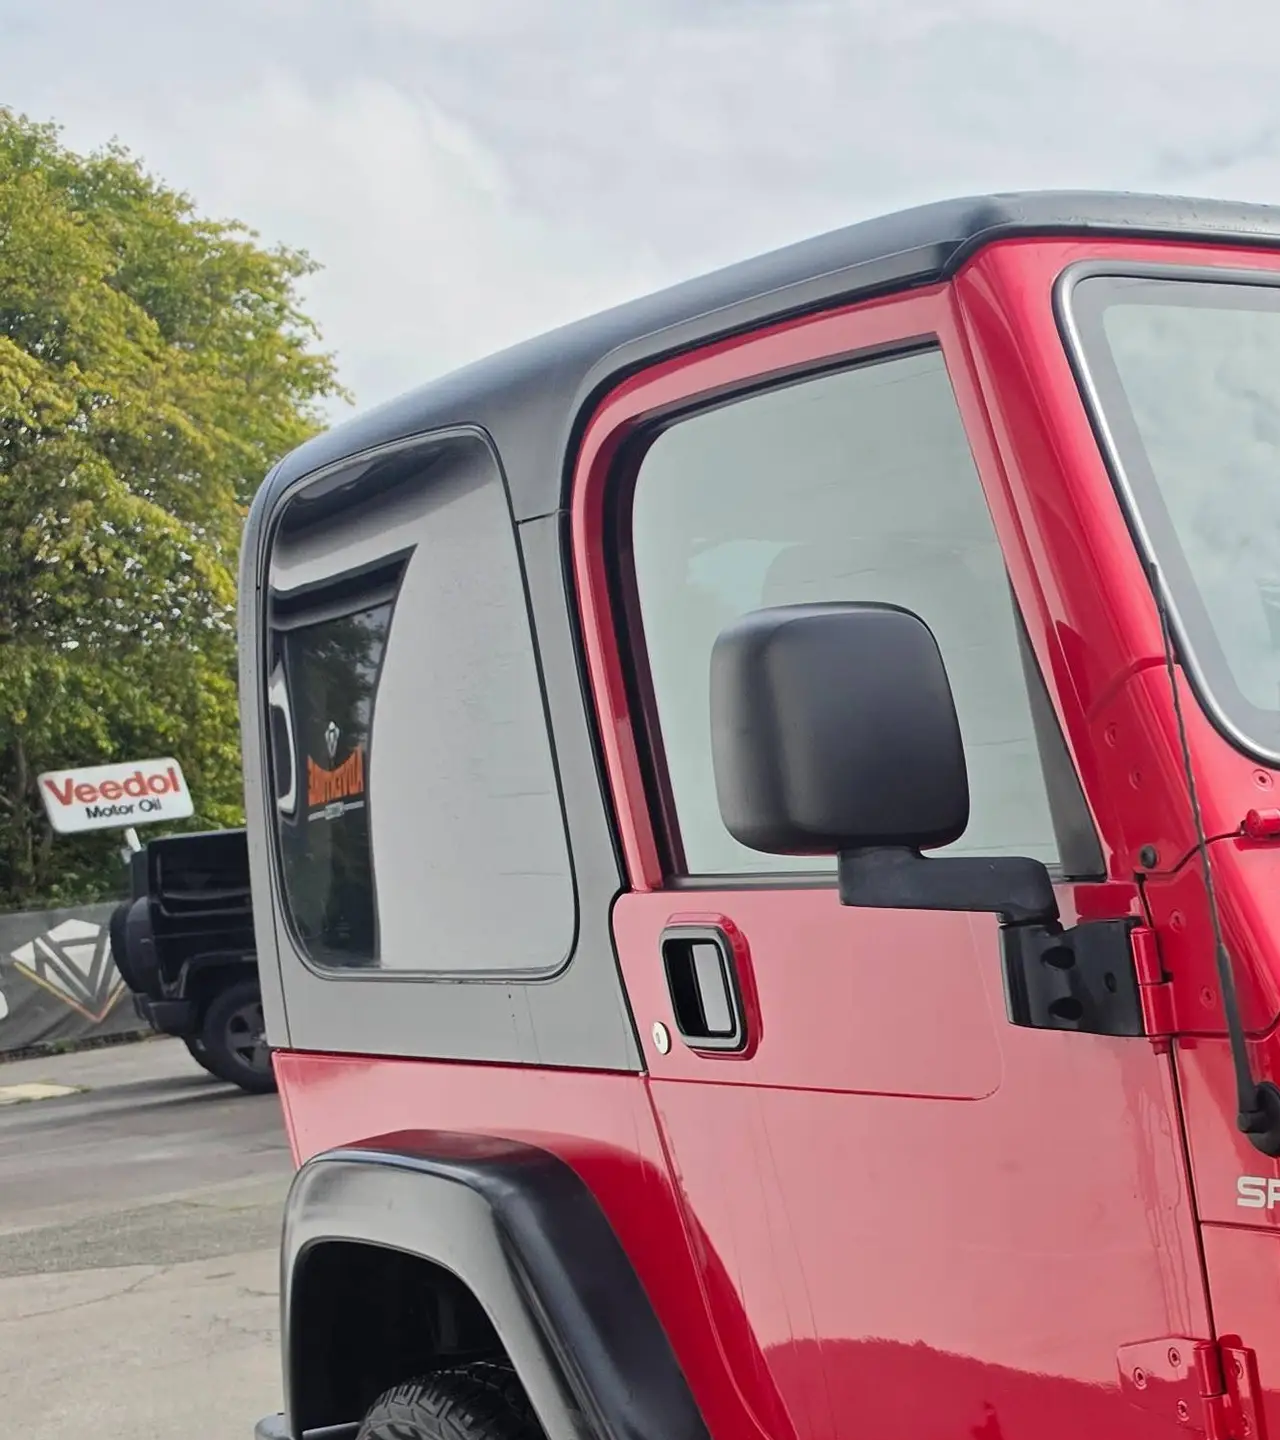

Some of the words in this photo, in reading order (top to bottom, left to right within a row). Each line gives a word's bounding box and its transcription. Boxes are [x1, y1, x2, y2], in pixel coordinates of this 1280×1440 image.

[44, 767, 180, 806] Veedol
[85, 803, 134, 820] Motor
[139, 798, 162, 813] Oil
